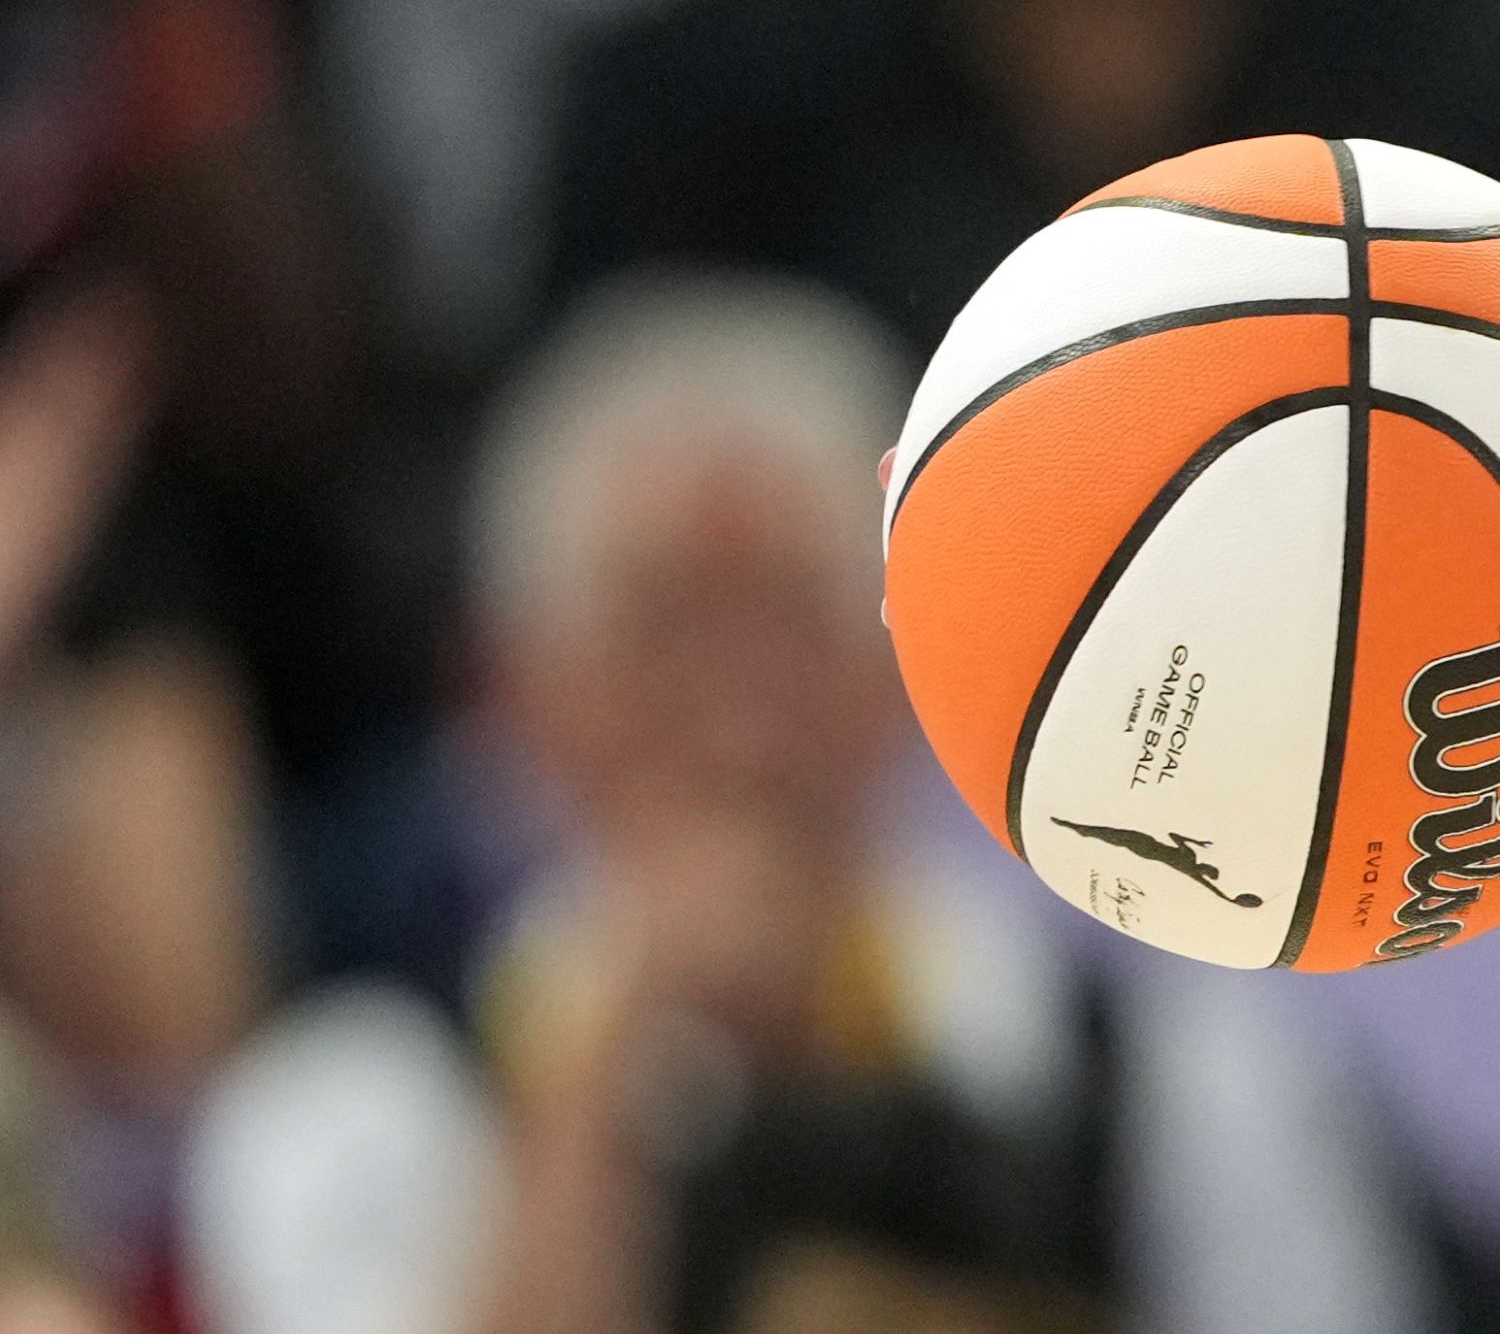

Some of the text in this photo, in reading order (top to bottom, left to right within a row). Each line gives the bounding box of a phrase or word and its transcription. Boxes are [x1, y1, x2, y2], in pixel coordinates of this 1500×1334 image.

[1129, 644, 1188, 790] GAME BALL
[1156, 672, 1206, 784] OFFICIAL
[1365, 841, 1383, 884] EVO
